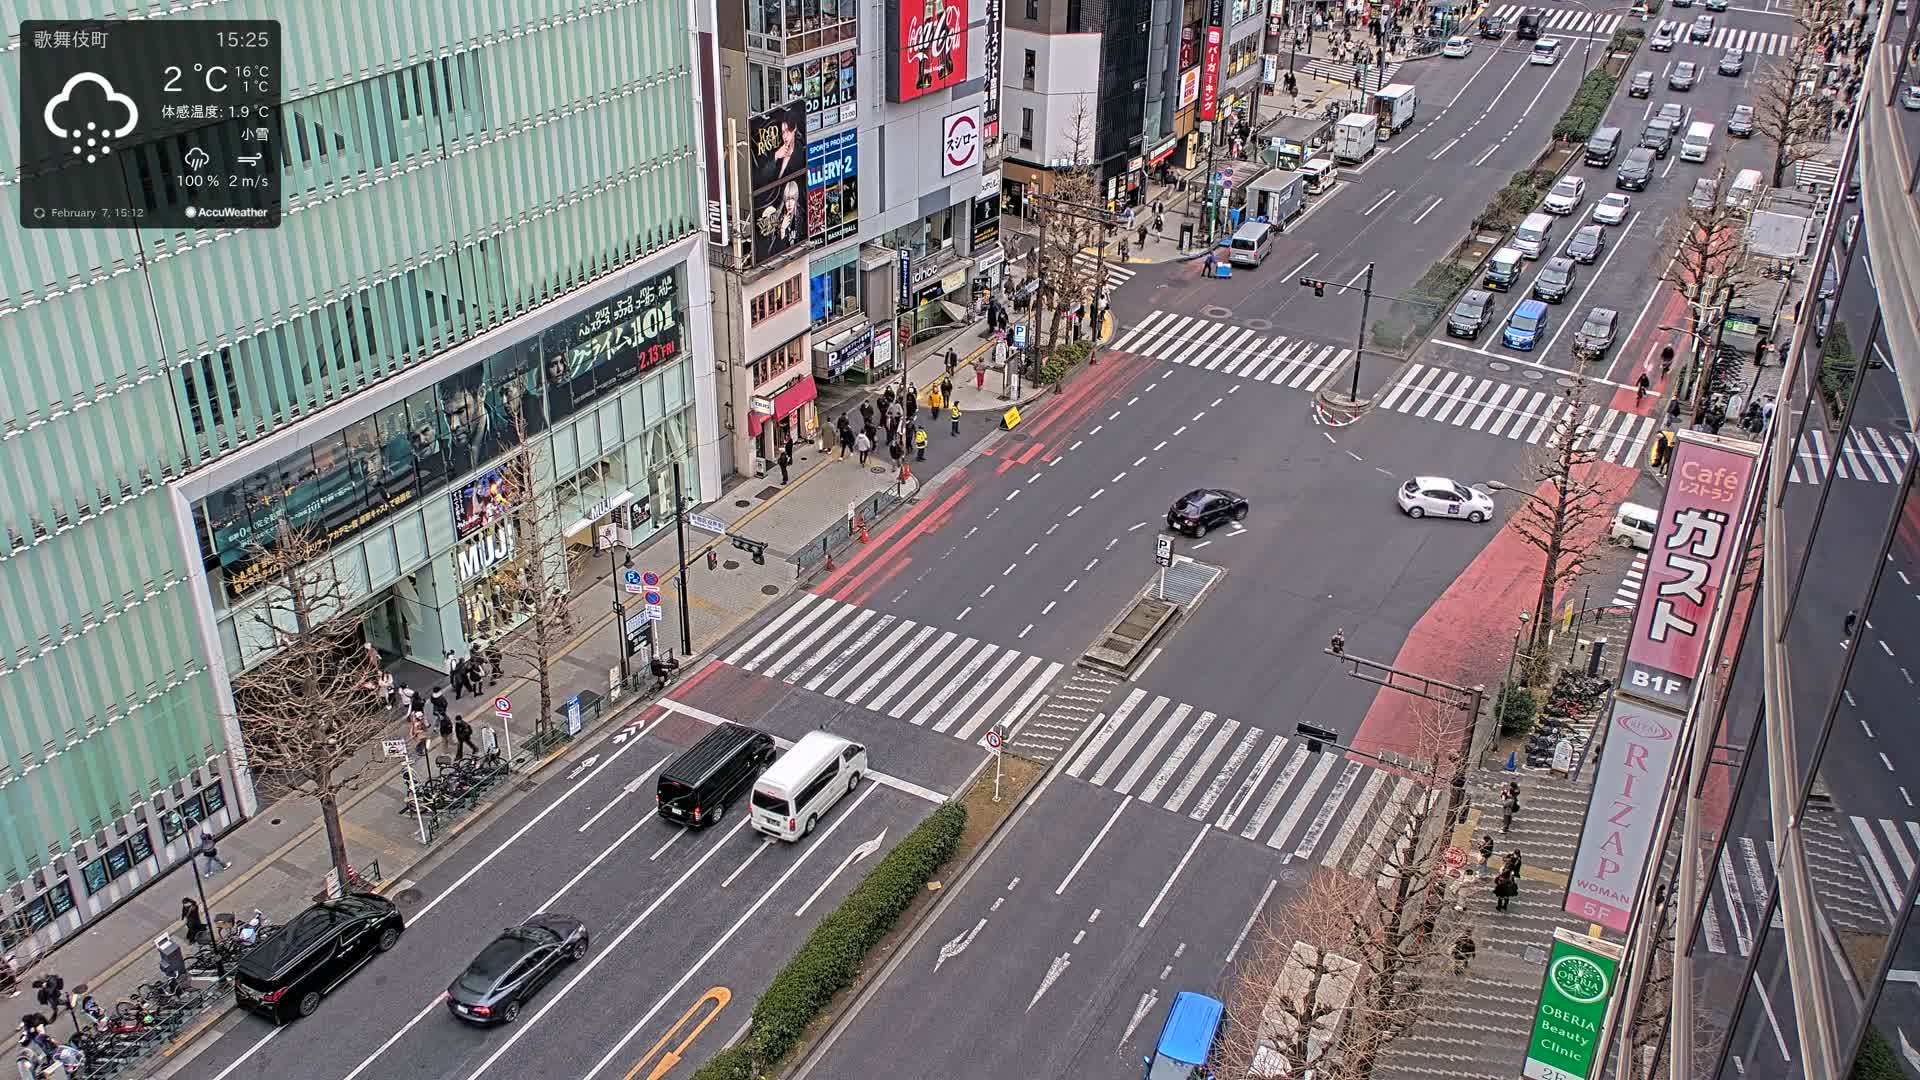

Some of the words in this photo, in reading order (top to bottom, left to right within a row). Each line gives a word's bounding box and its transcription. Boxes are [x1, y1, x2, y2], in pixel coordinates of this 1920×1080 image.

[1203, 47, 1219, 111] バーガーキング
[823, 89, 852, 109] HALL
[809, 142, 830, 154] SPORTS
[841, 133, 855, 145] SHOP
[945, 132, 978, 153] スシロー
[807, 155, 853, 187] ALLERY-2
[708, 199, 721, 233] MUJI
[827, 224, 857, 241] BASKETBALL
[594, 306, 611, 321] クリス
[616, 295, 633, 308] マーク
[613, 305, 634, 321] ラファロ
[1016, 326, 1024, 336] P
[639, 344, 659, 370] 2.13
[661, 340, 675, 359] FRI
[1680, 461, 1739, 491] Café
[1678, 481, 1736, 504] レストラン
[591, 497, 614, 519] MUJI
[458, 522, 514, 581] MUJI
[1159, 539, 1168, 549] P
[1649, 507, 1729, 642] ガスト
[1631, 669, 1681, 695] B1F
[1597, 741, 1649, 882] RIZAP
[1576, 878, 1630, 904] WOMAN
[1583, 901, 1610, 921] 5F
[1557, 969, 1599, 991] OBERIA
[1541, 1003, 1596, 1033] OBERIA
[1541, 1020, 1590, 1047] Beauty
[1541, 1038, 1582, 1062] Clinic
